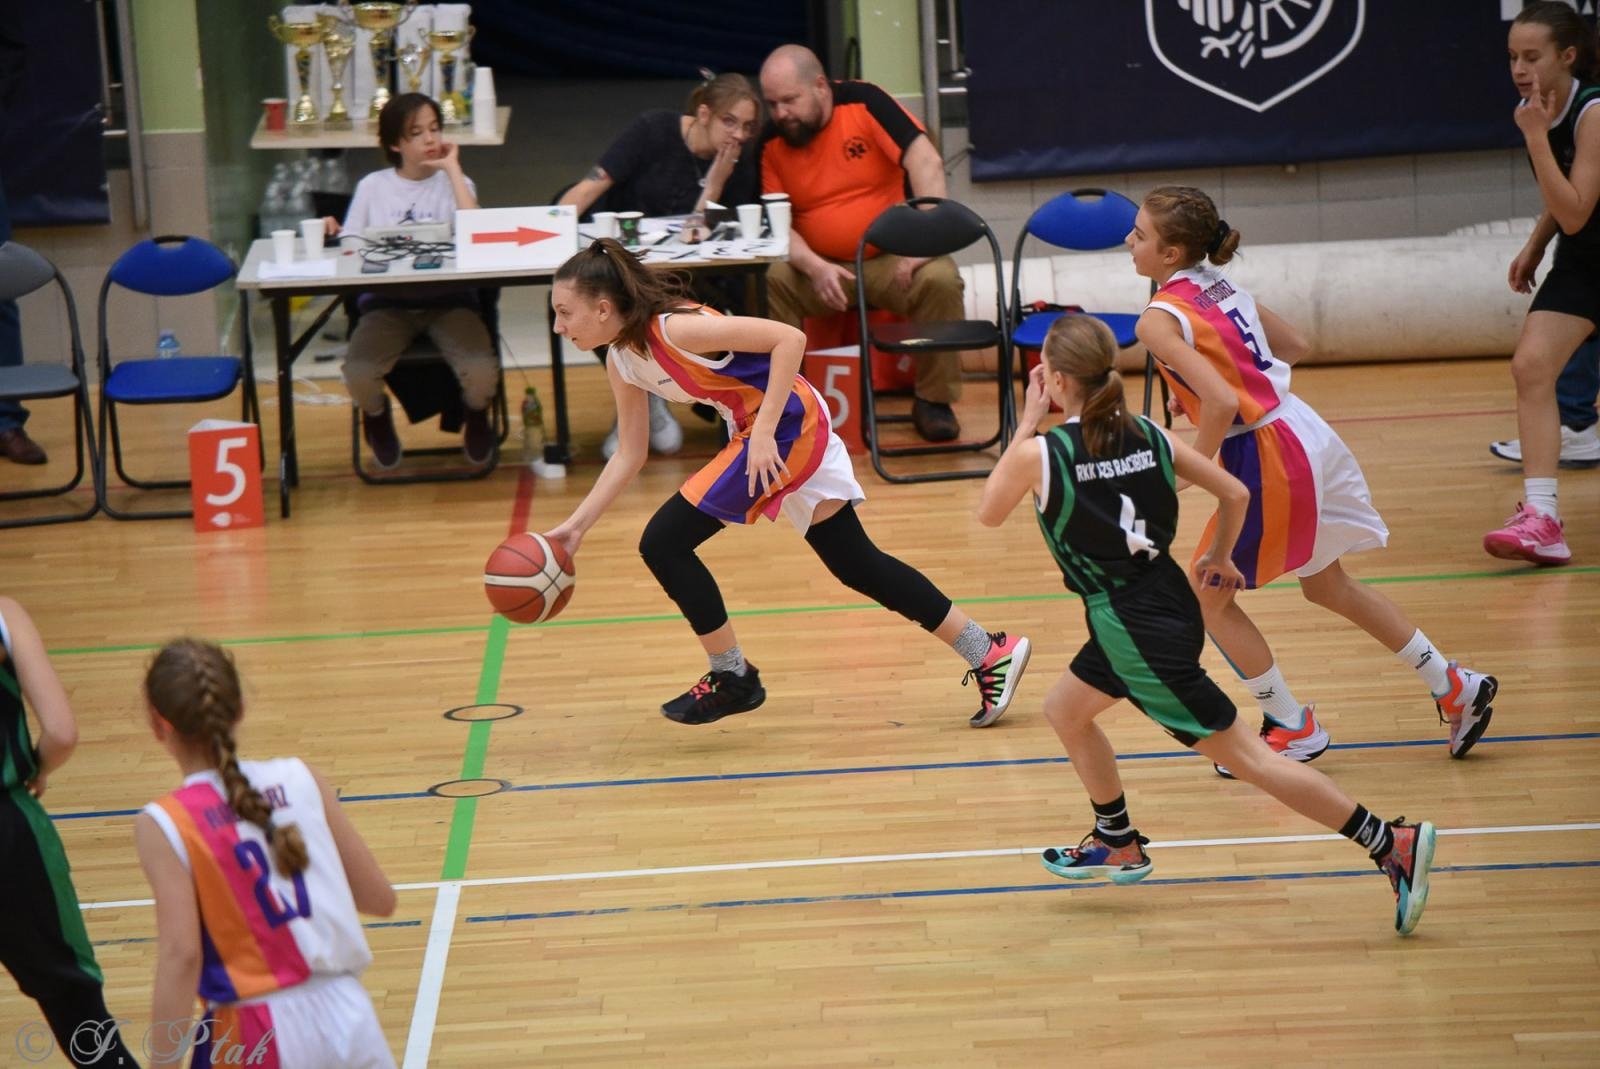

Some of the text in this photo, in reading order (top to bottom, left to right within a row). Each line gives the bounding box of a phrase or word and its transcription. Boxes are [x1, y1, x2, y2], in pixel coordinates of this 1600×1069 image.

[1225, 307, 1273, 372] 5
[824, 364, 851, 429] 5
[205, 437, 248, 506] 5
[1075, 462, 1097, 482] RKK
[1119, 493, 1160, 561] 4
